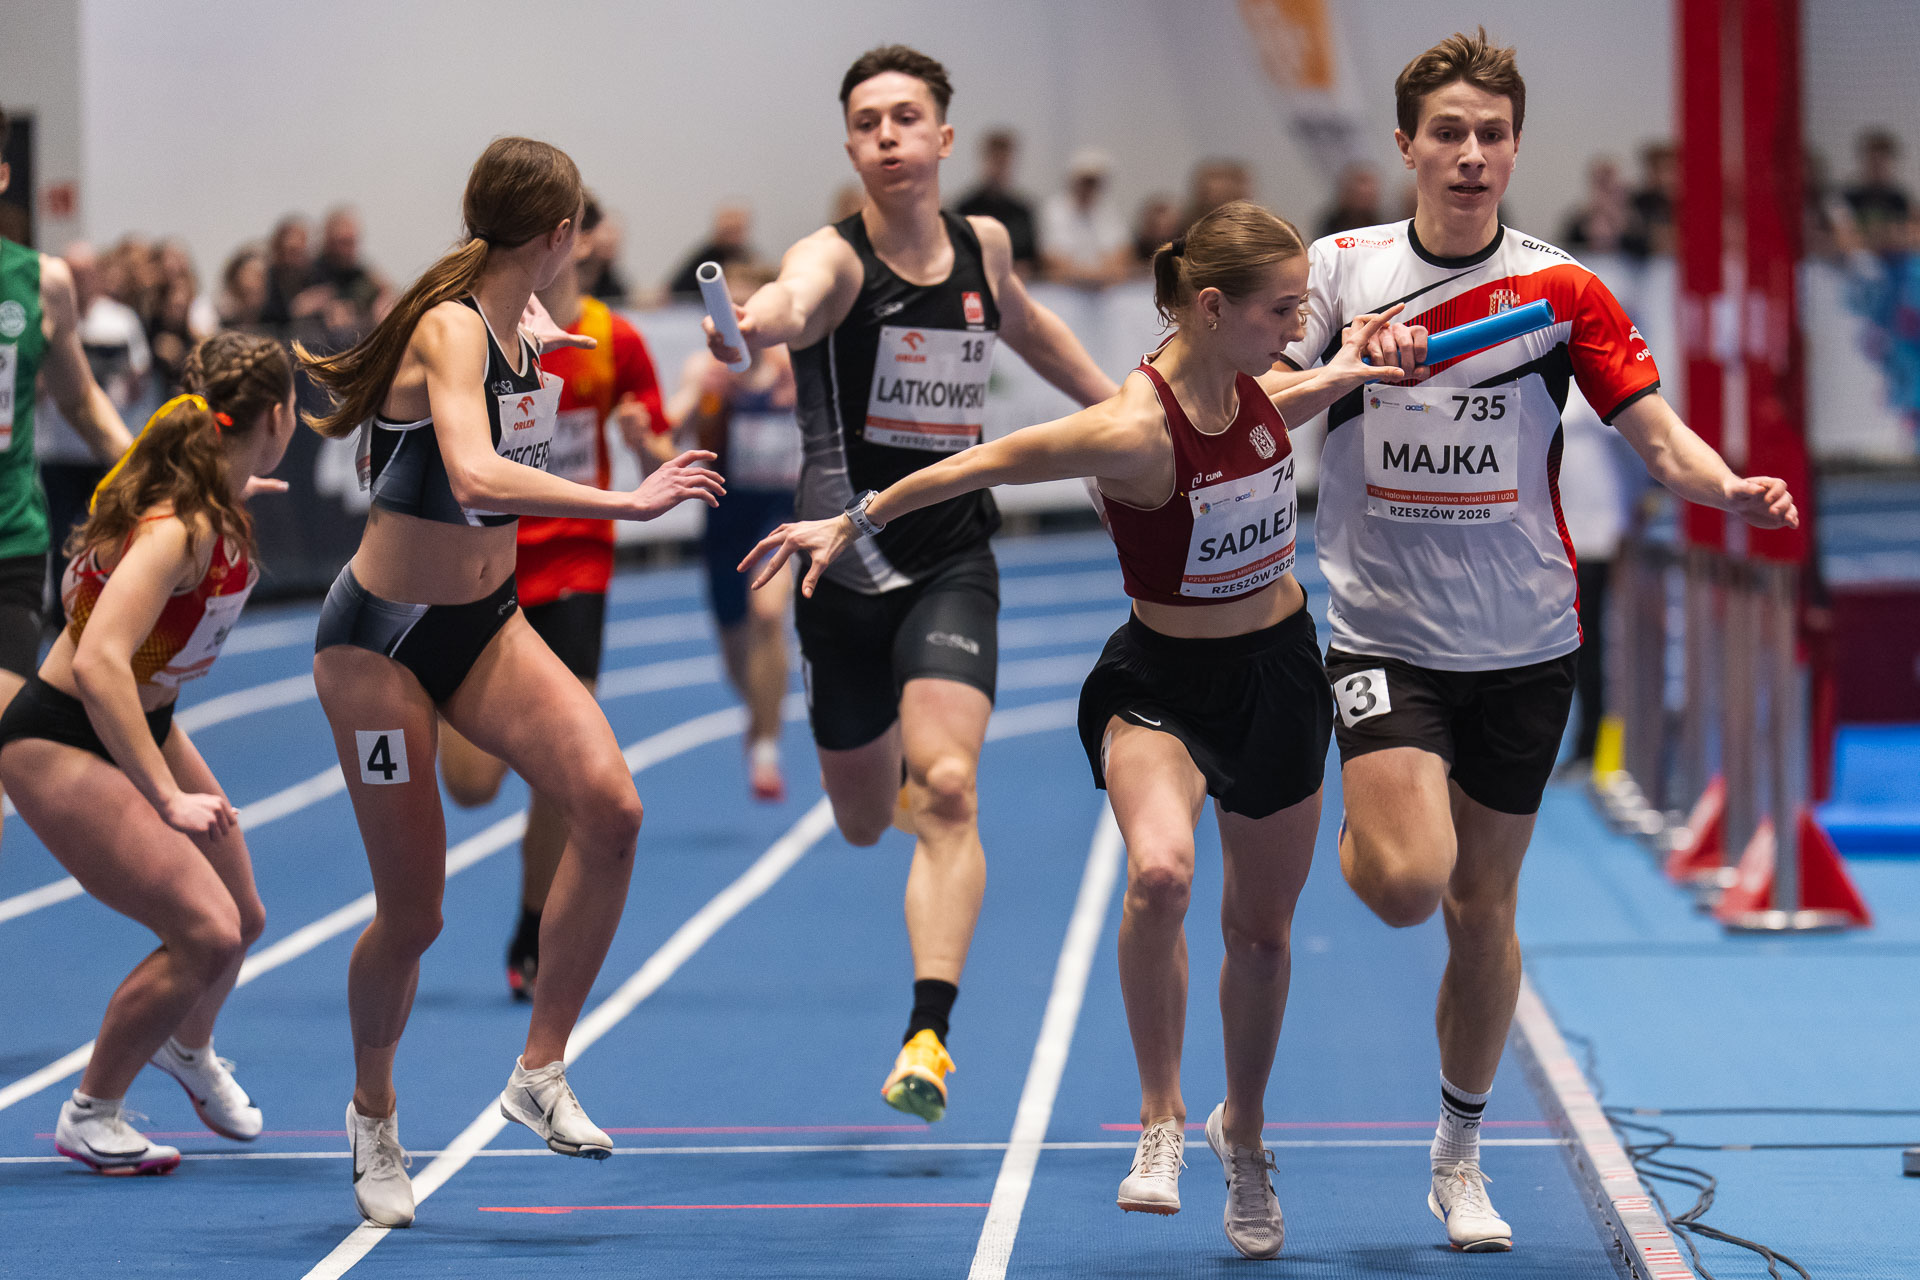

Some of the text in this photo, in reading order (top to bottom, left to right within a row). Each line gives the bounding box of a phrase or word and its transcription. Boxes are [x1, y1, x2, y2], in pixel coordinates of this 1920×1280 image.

[962, 340, 985, 363] 18
[1452, 395, 1506, 421] 735
[513, 419, 535, 431] ORLEN
[1383, 440, 1500, 475] MAJKA
[1385, 490, 1411, 500] Halowe
[1413, 494, 1459, 503] Mistrzostwa
[1460, 495, 1482, 503] Polski
[1501, 492, 1515, 500] U20
[1390, 505, 1491, 520] RZESZÓW 2026
[1198, 500, 1297, 562] SADLEJ
[1212, 554, 1295, 594] RZESZÓW 2026
[1345, 675, 1377, 717] 3
[367, 735, 398, 780] 4
